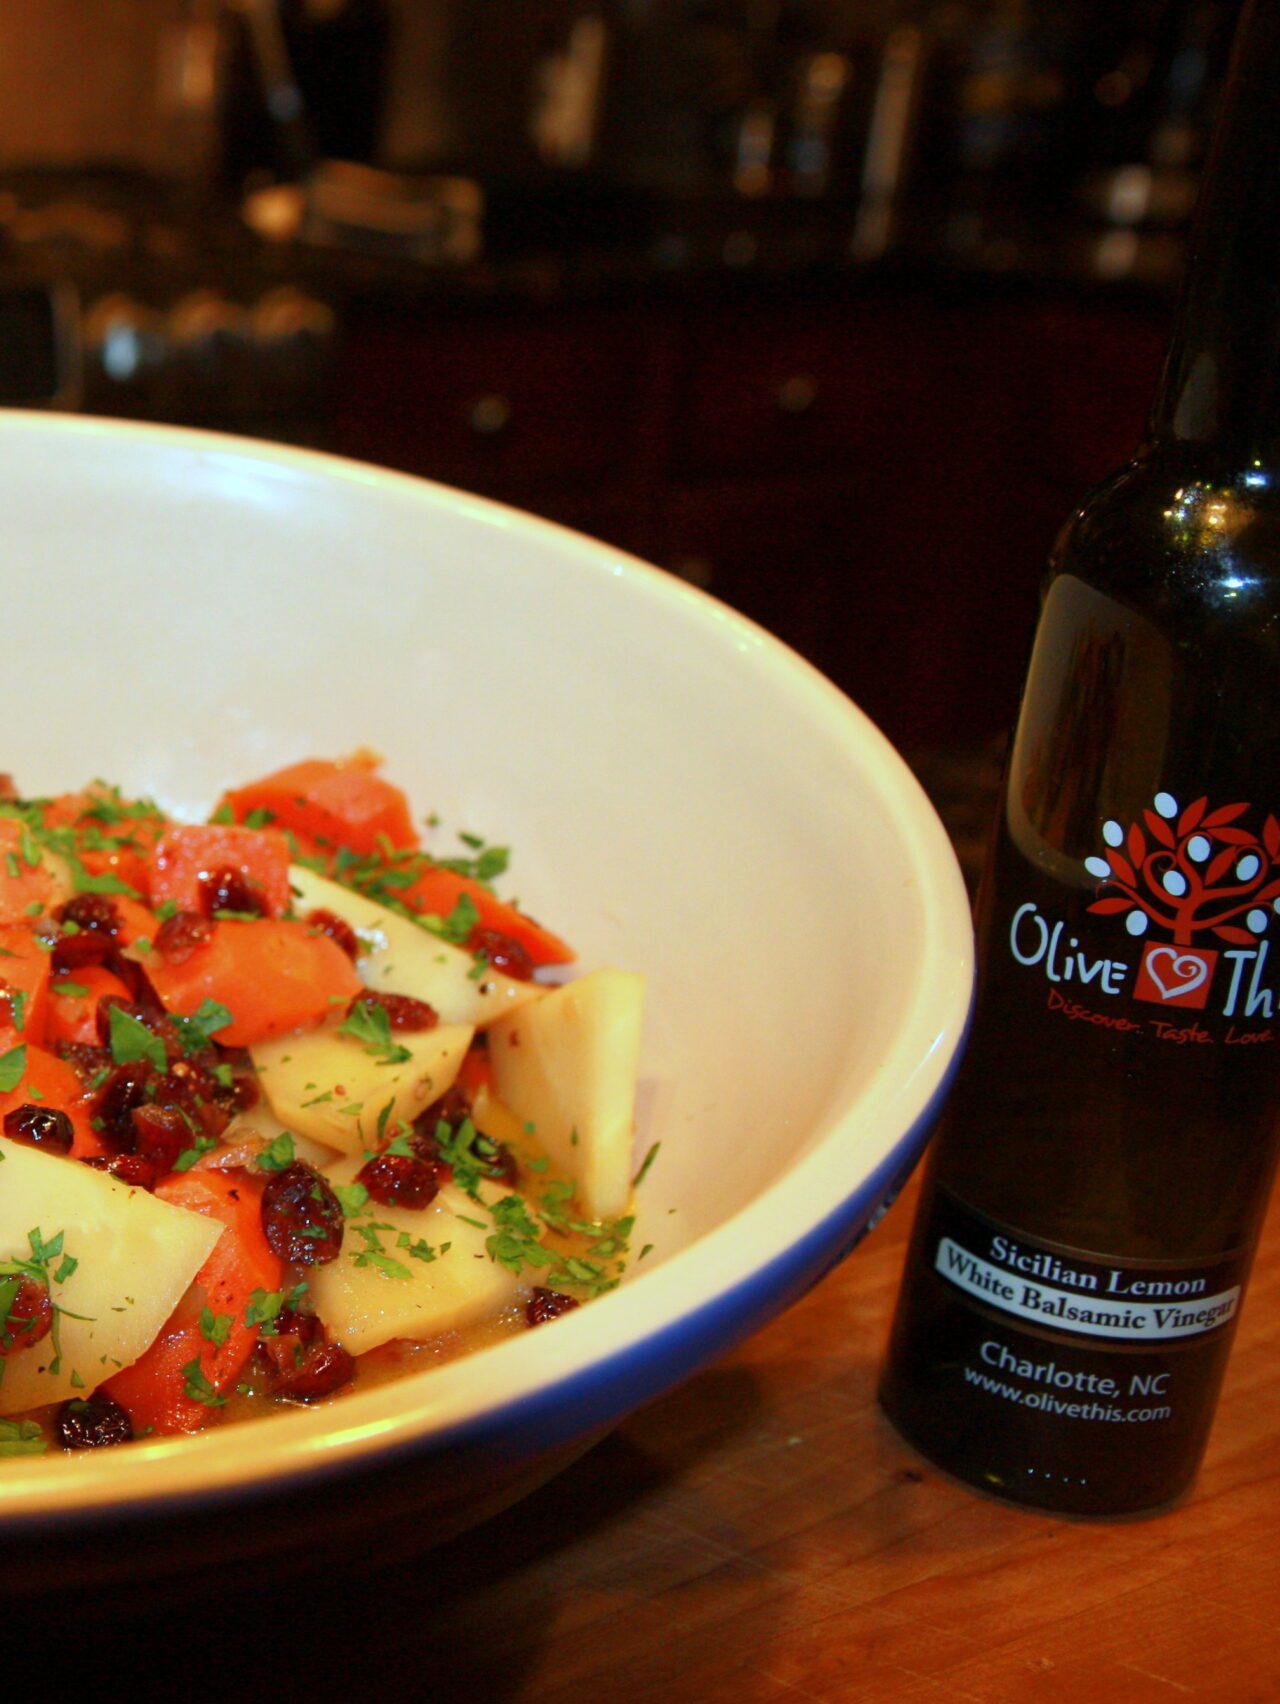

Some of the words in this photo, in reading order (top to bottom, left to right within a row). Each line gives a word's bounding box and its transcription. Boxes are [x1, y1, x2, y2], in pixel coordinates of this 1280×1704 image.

[1223, 940, 1280, 1018] Th
[945, 1245, 1015, 1301] White
[1019, 1287, 1146, 1330] Balsamic
[1153, 1298, 1235, 1330] Vinegar
[989, 1235, 1098, 1290] Sicilian
[1106, 1270, 1207, 1296] Lemon
[963, 1366, 1171, 1422] www.olivethis.com
[980, 1340, 1121, 1399] Charlotte,
[1129, 1373, 1170, 1396] NC
